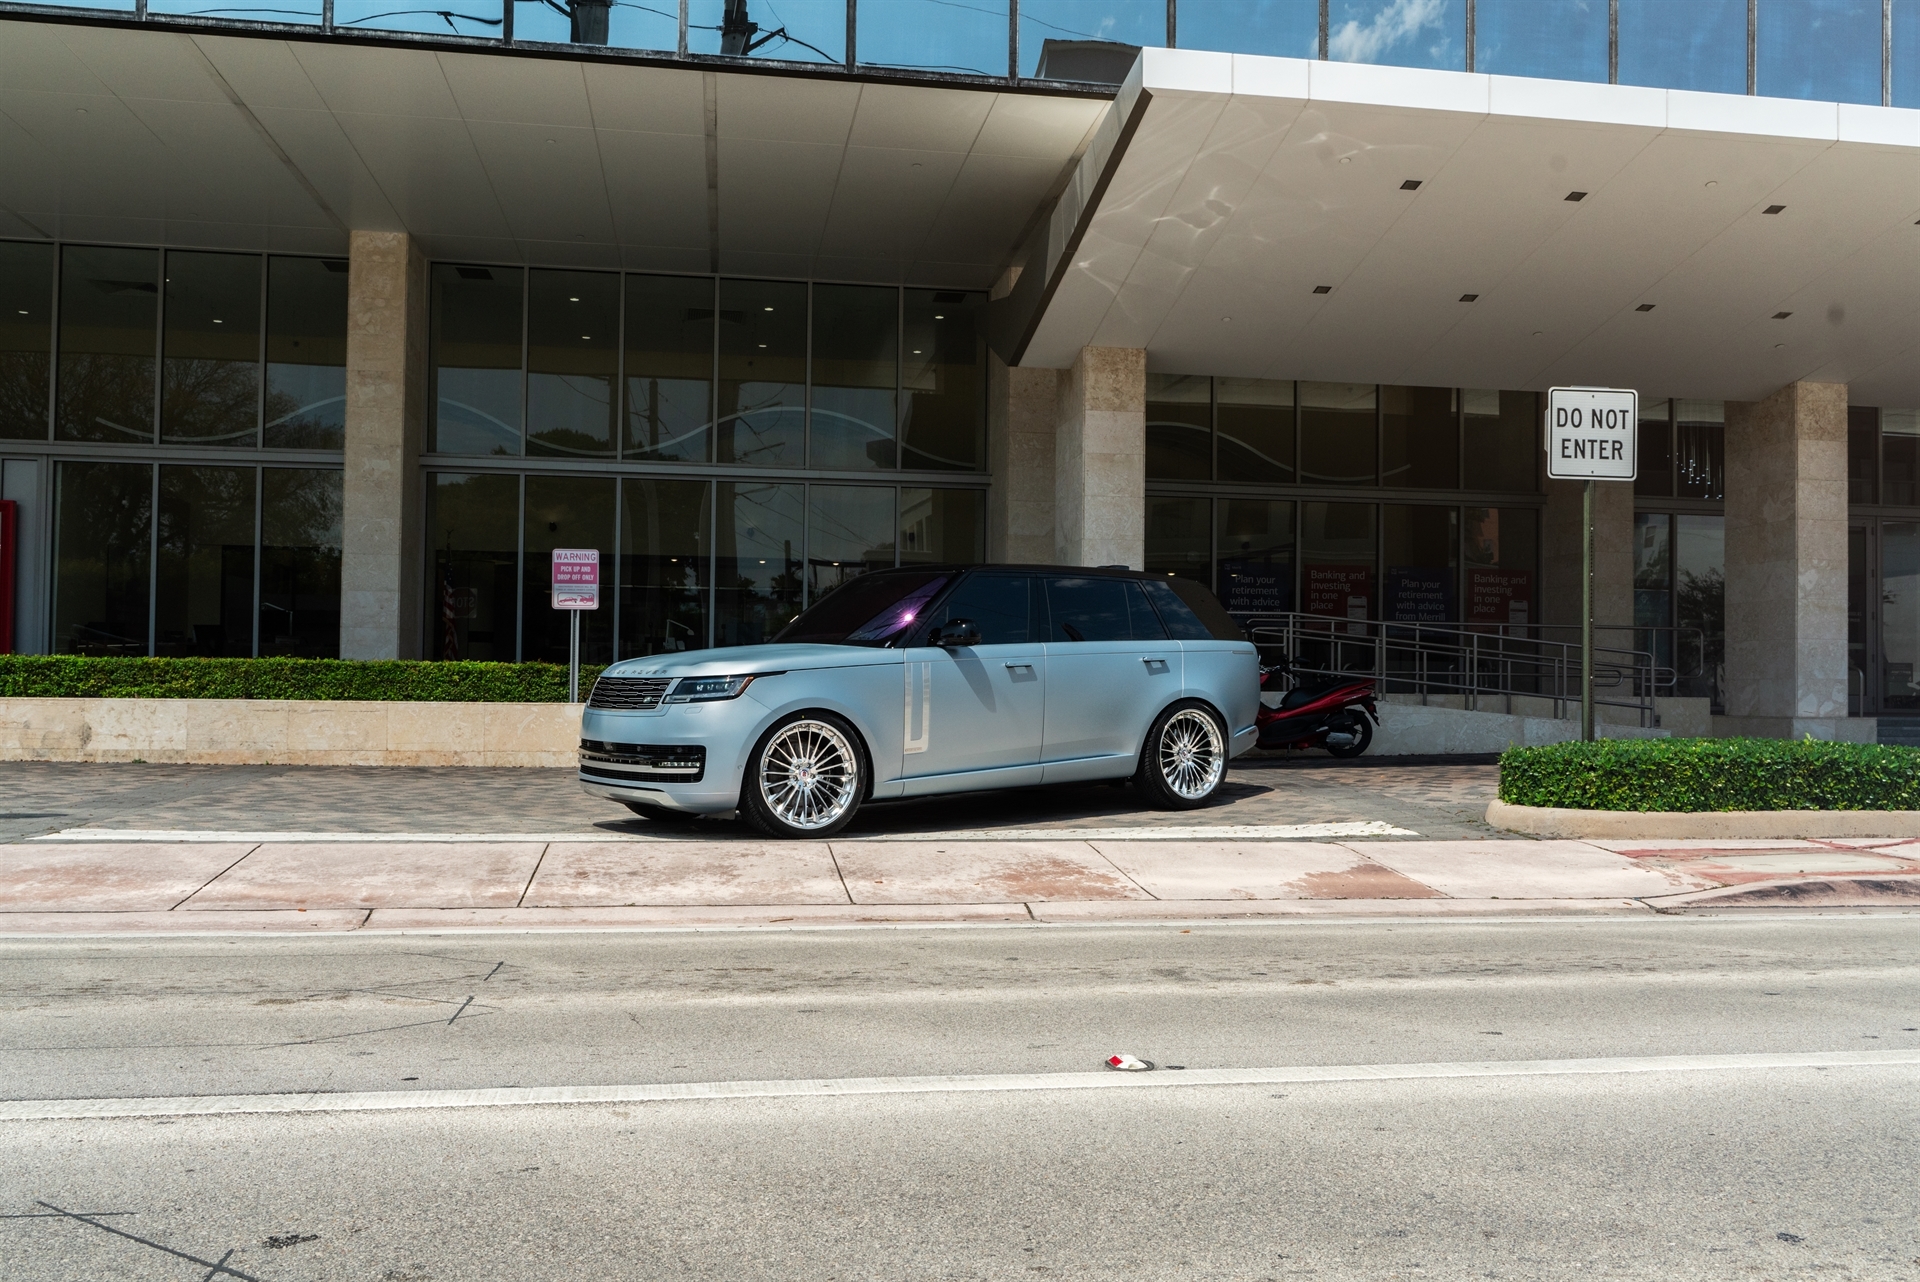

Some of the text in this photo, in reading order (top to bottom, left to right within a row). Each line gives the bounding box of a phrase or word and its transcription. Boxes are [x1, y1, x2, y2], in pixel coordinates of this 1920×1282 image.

[1557, 408, 1629, 429] DO NOT
[1561, 438, 1623, 460] ENTER
[556, 553, 596, 561] WARNING
[1235, 574, 1276, 586] Plan your
[1311, 570, 1366, 582] Banking and
[1474, 574, 1527, 586] Banking and
[1311, 581, 1351, 592] investing
[1401, 579, 1441, 590] Plan your
[1232, 586, 1279, 595] retirement
[1311, 591, 1338, 600] in one
[1398, 590, 1443, 600] retirement
[1474, 585, 1513, 596] investing
[1230, 597, 1280, 606] with advice
[1474, 594, 1482, 602] in
[1310, 600, 1334, 612] place
[1396, 601, 1445, 611] with advice
[1473, 604, 1496, 614] place
[1395, 611, 1446, 621] from Merrill
